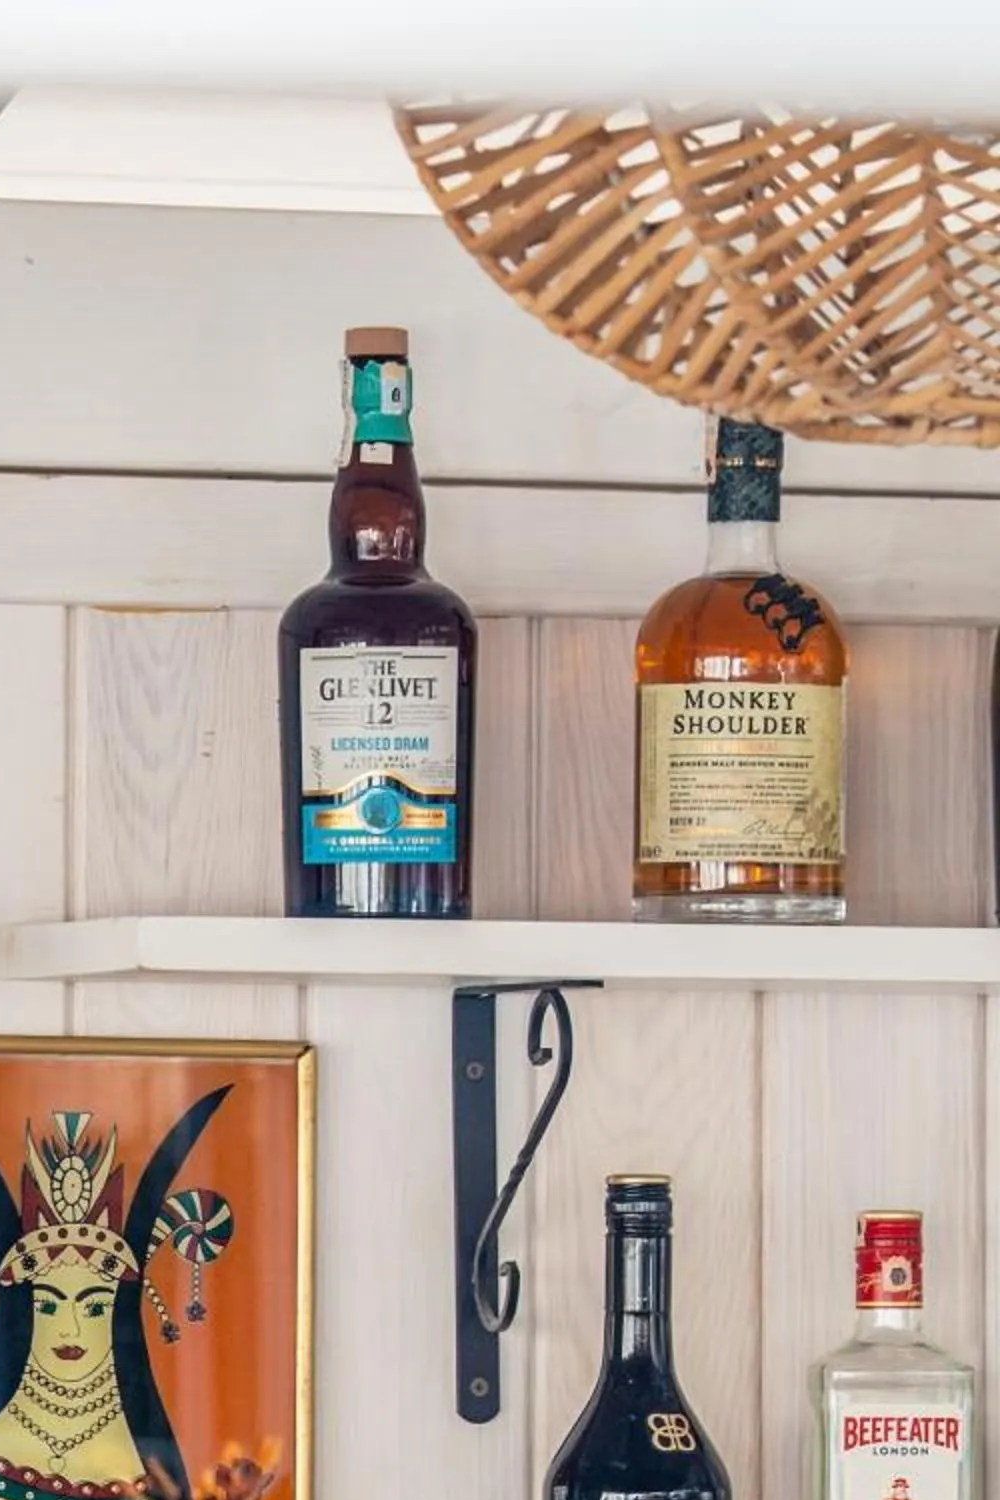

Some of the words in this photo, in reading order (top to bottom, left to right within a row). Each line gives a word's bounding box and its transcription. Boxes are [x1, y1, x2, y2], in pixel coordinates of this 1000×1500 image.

[364, 660, 397, 676] THE
[319, 677, 437, 701] GLENLIVET
[685, 690, 796, 710] MONKEY
[366, 702, 393, 724] 12
[673, 715, 808, 735] SHOULDER
[331, 738, 391, 751] LICENSED
[394, 738, 429, 751] DRAM
[844, 1417, 959, 1451] BEEFEATER
[872, 1447, 929, 1456] LONDON
